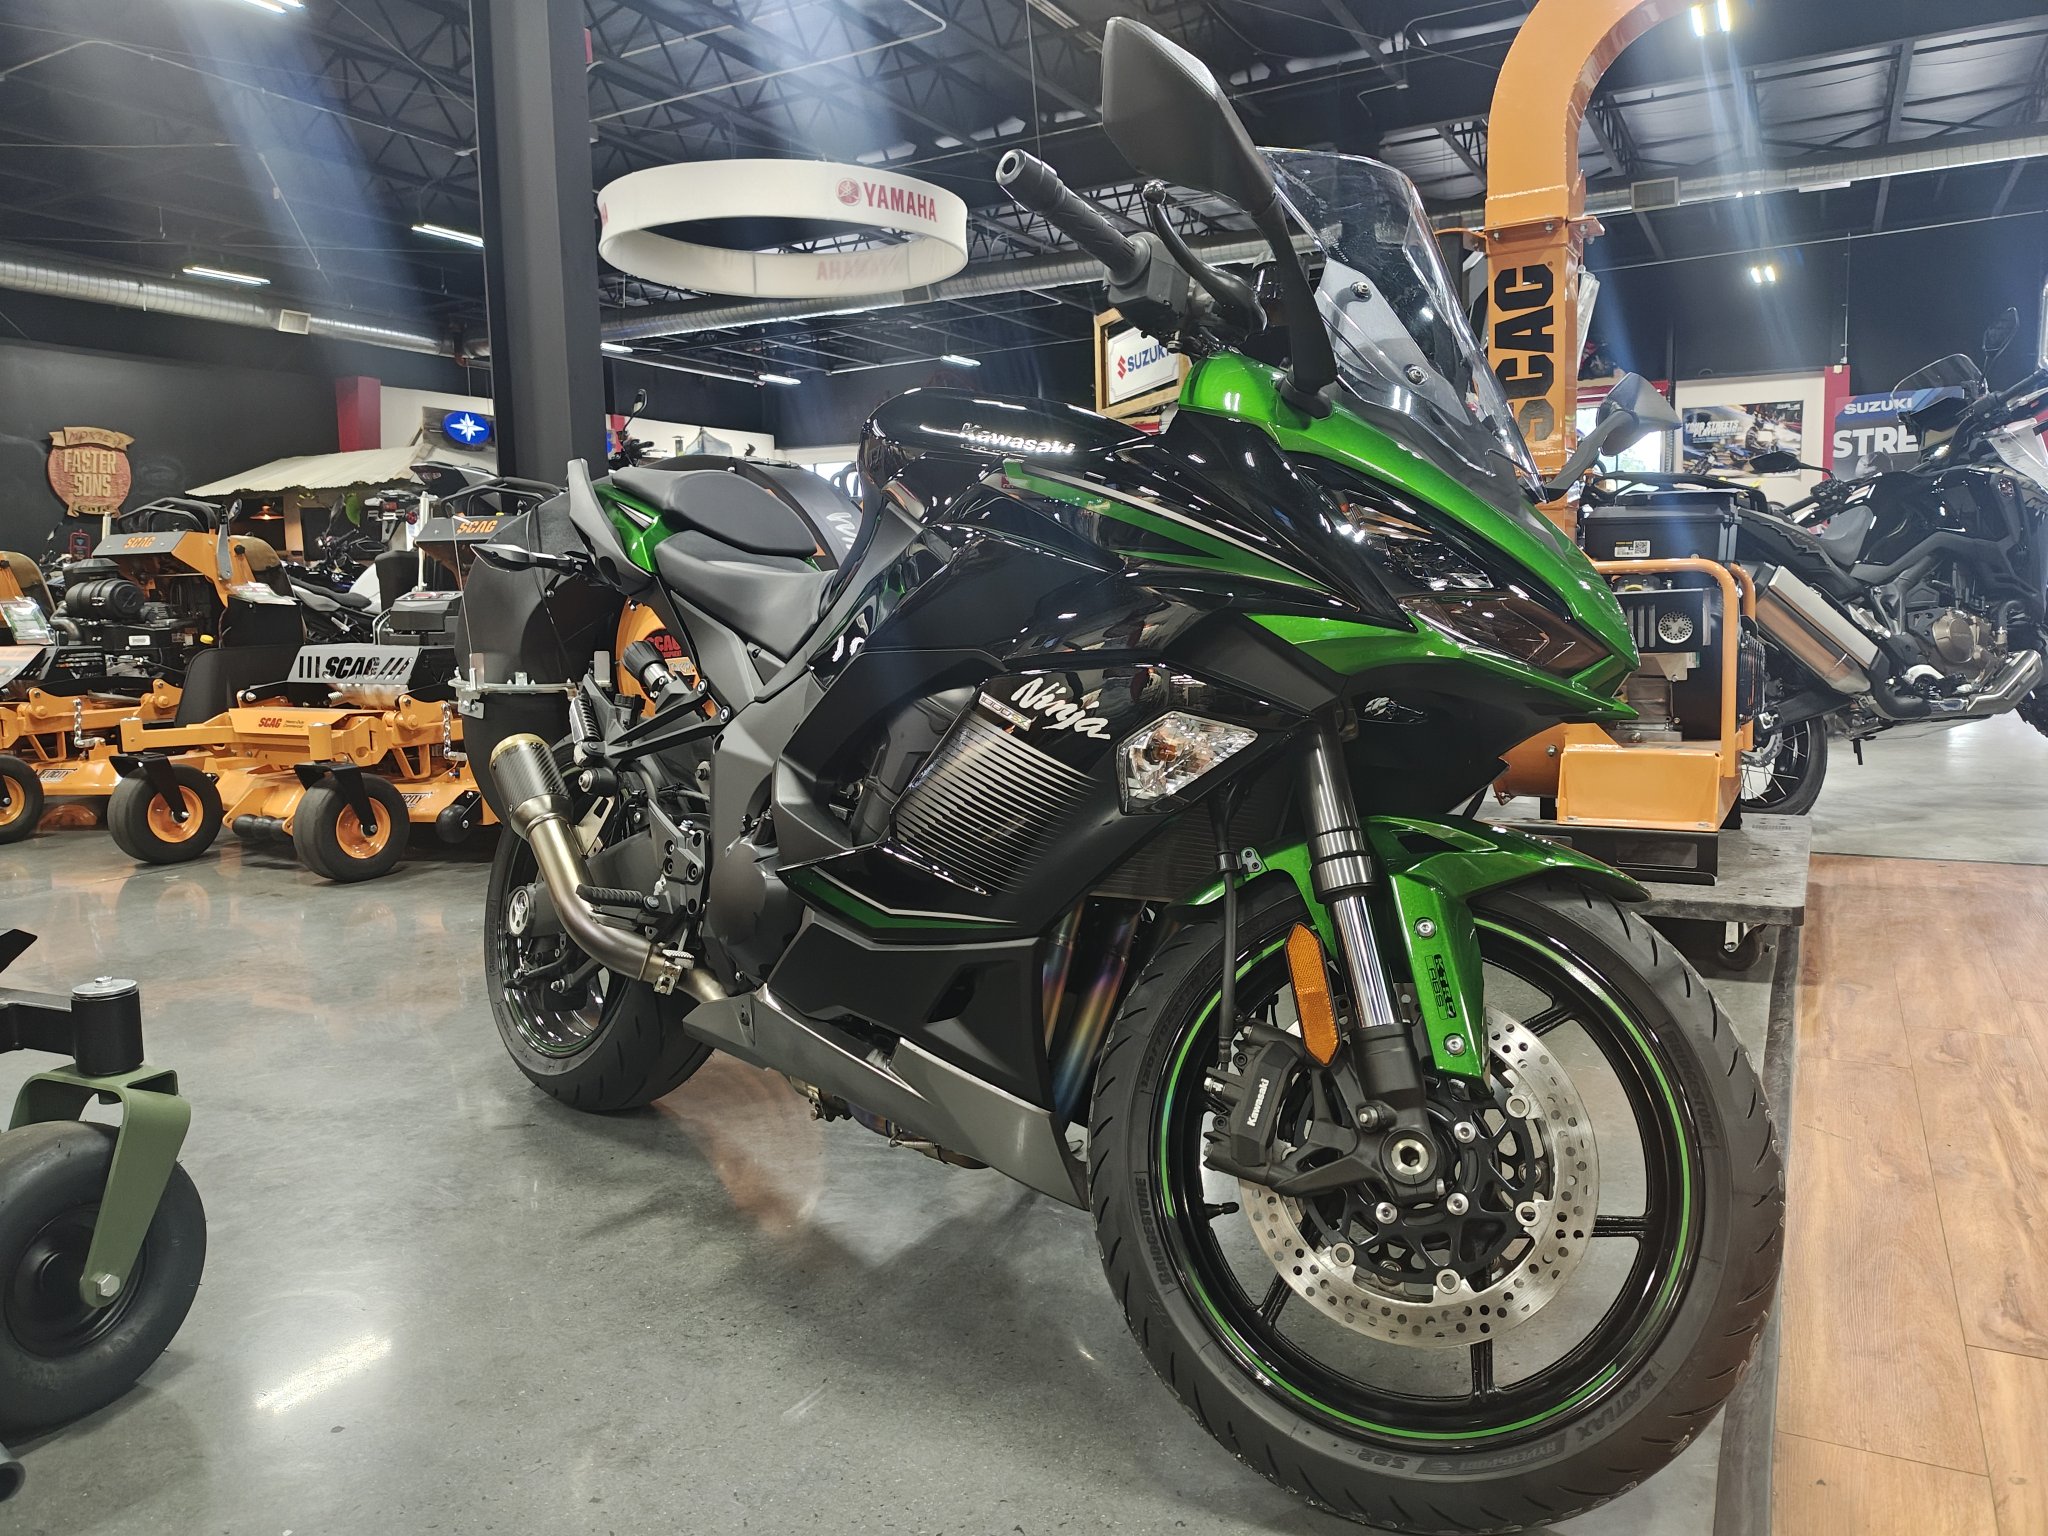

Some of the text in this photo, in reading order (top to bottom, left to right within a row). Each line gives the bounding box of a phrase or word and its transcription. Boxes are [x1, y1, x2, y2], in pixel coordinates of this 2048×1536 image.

[863, 182, 938, 222] YAMAHA
[1127, 344, 1169, 373] SUZUK
[1494, 263, 1554, 443] SCAG
[1844, 398, 1913, 415] SUZUKI
[960, 422, 1076, 454] Kawasaki
[63, 448, 117, 475] FASTER
[73, 473, 112, 497] SONS
[456, 519, 498, 534] SCAG
[124, 536, 156, 549] SCAG
[322, 656, 380, 679] SCAG
[258, 717, 282, 728] SCAG
[1010, 677, 1111, 740] Ninja
[1246, 1077, 1270, 1127] Kawasaki
[1134, 1176, 1175, 1287] BRIDGESTONE
[1575, 1372, 1659, 1443] BATTLAX
